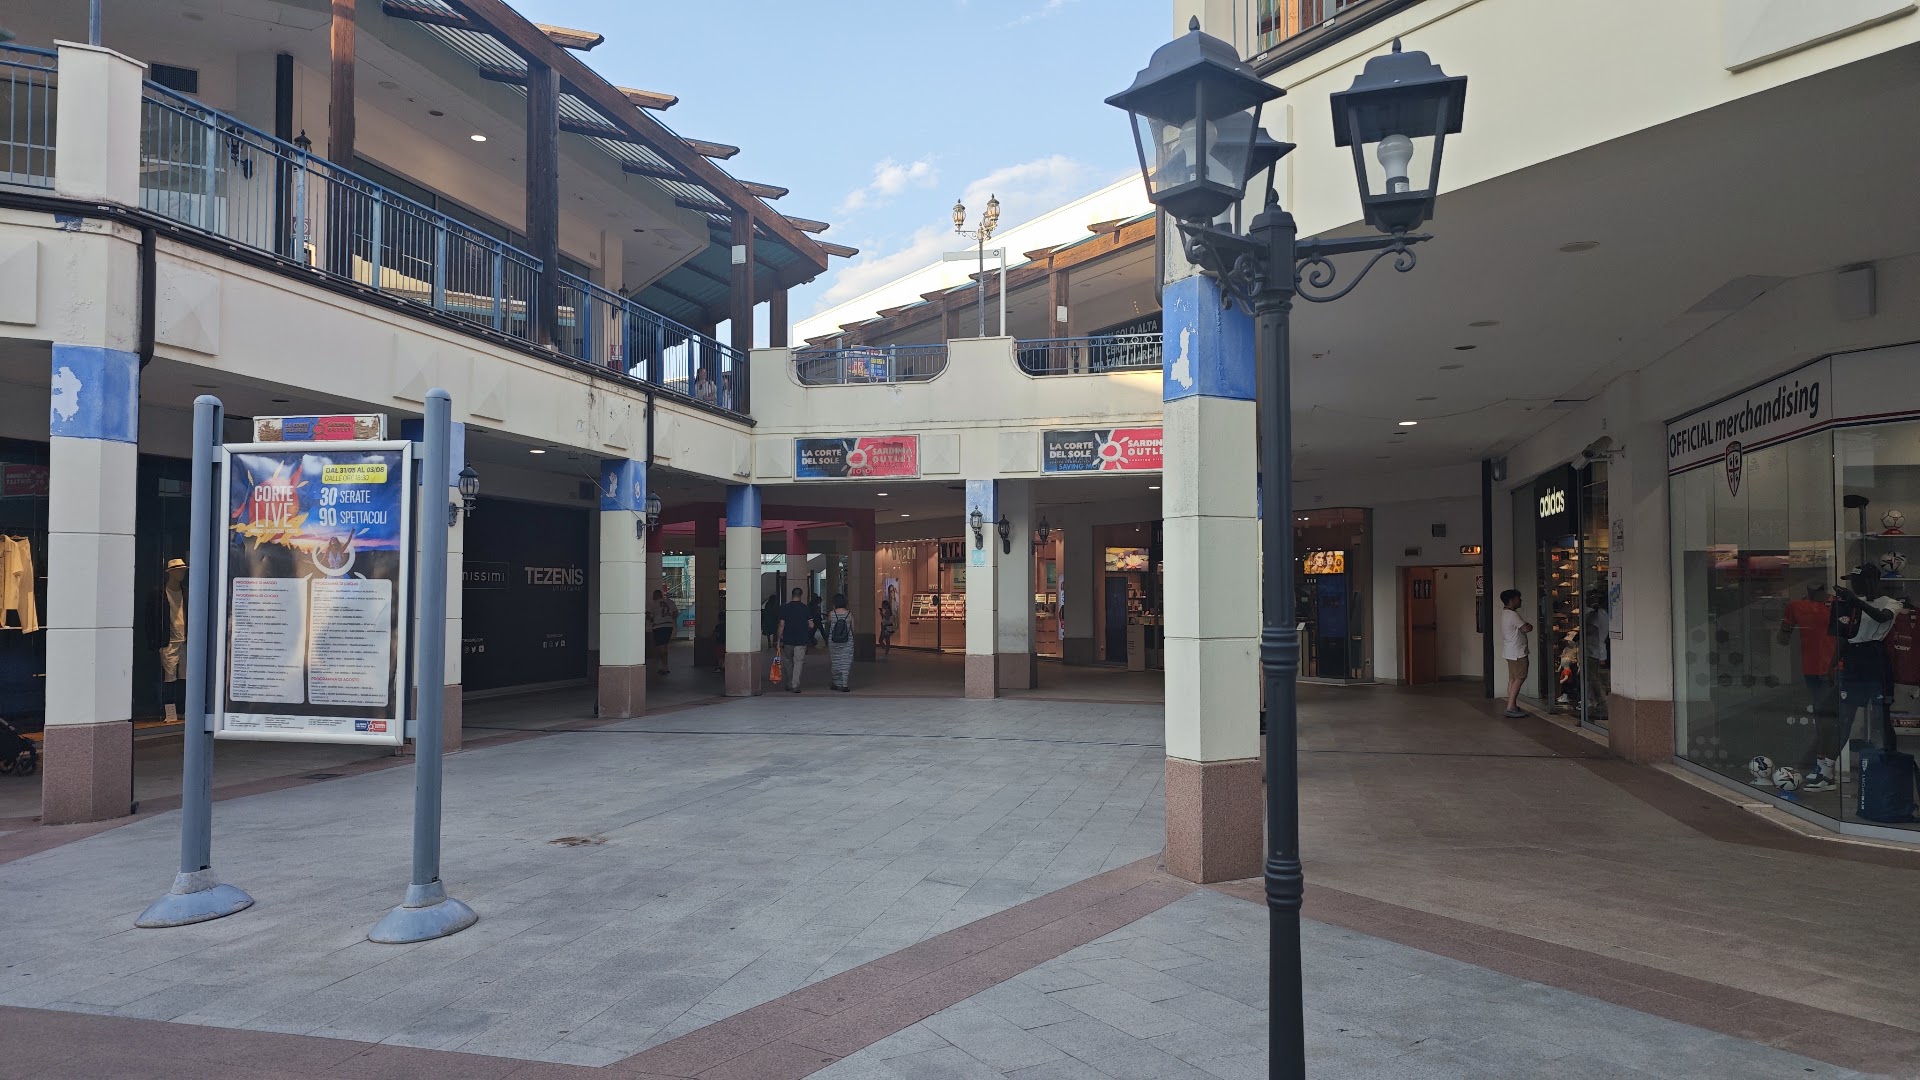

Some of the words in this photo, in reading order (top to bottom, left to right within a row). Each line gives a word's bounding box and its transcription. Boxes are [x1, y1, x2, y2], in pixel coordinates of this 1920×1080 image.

[1138, 320, 1158, 334] ALTA
[1670, 420, 1713, 458] OFFICIAL
[1715, 380, 1820, 441] merchandising
[814, 448, 842, 456] CORTE
[1050, 442, 1062, 450] LA
[1064, 440, 1094, 450] CORTE
[872, 455, 912, 464] OUTLET
[1050, 450, 1066, 459] DEL
[1067, 450, 1092, 458] SOLE
[254, 485, 294, 502] CORTE
[319, 487, 338, 506] 30
[340, 490, 370, 504] SERATE
[1540, 486, 1565, 518] adidas
[256, 503, 294, 528] LIVE
[319, 508, 338, 527] 90
[340, 510, 388, 525] SPETTACOLI
[524, 564, 584, 586] TEZENIS
